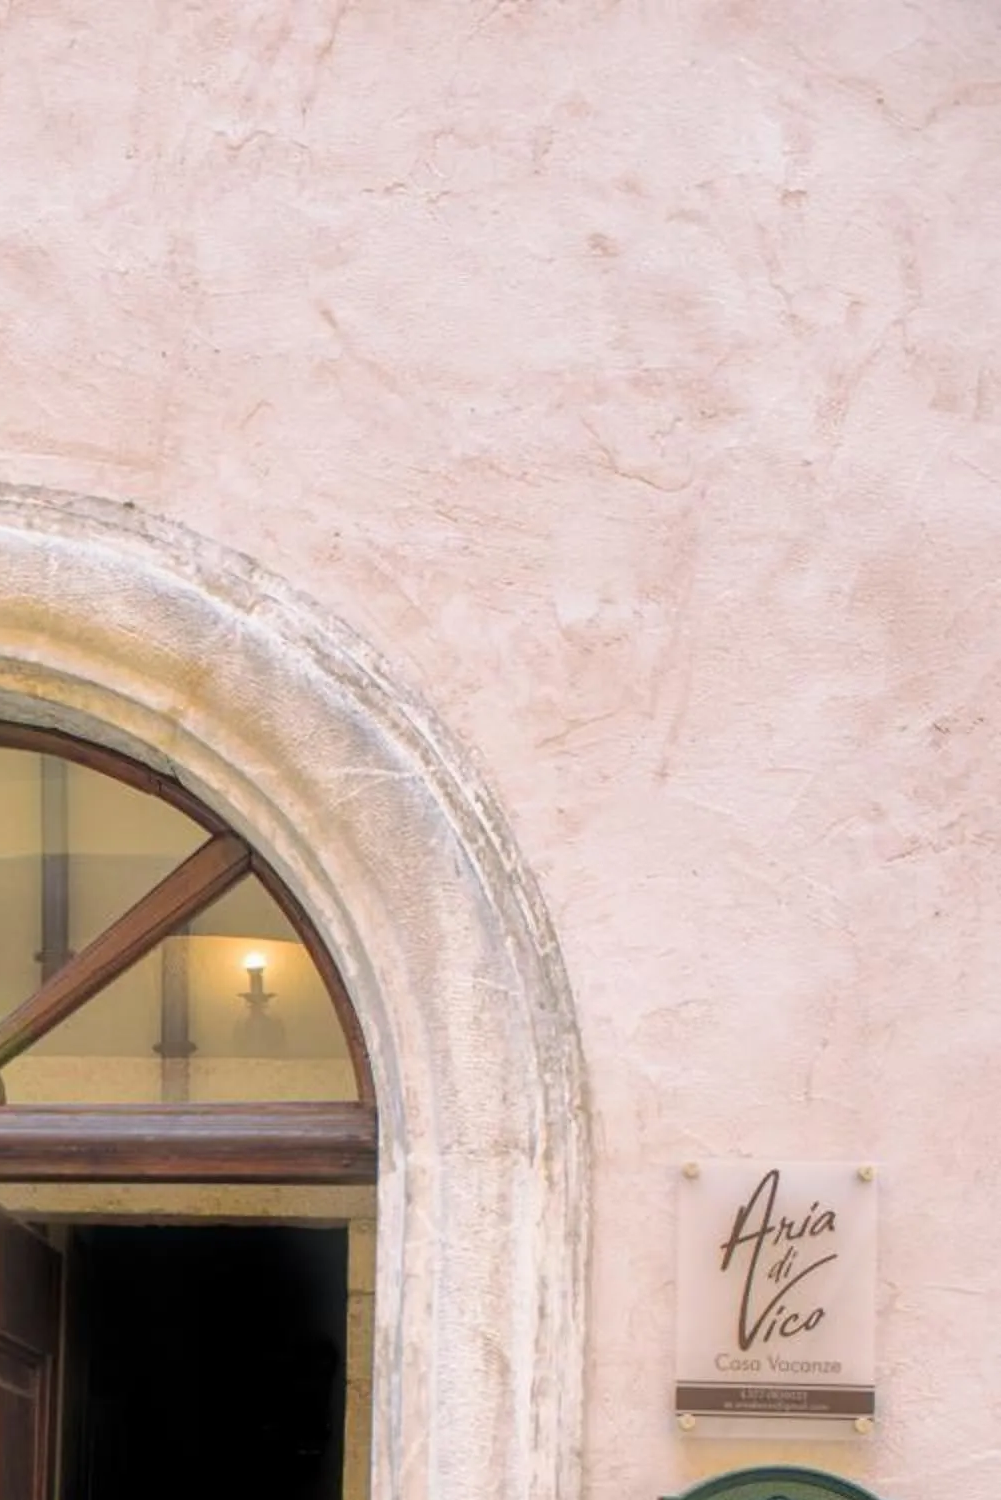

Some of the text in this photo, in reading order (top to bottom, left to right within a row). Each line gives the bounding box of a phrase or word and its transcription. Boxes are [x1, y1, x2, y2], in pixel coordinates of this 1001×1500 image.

[720, 1168, 836, 1272] Aria
[767, 1245, 797, 1284] di
[738, 1253, 838, 1352] Vico
[714, 1353, 842, 1375] Casa Vacanze
